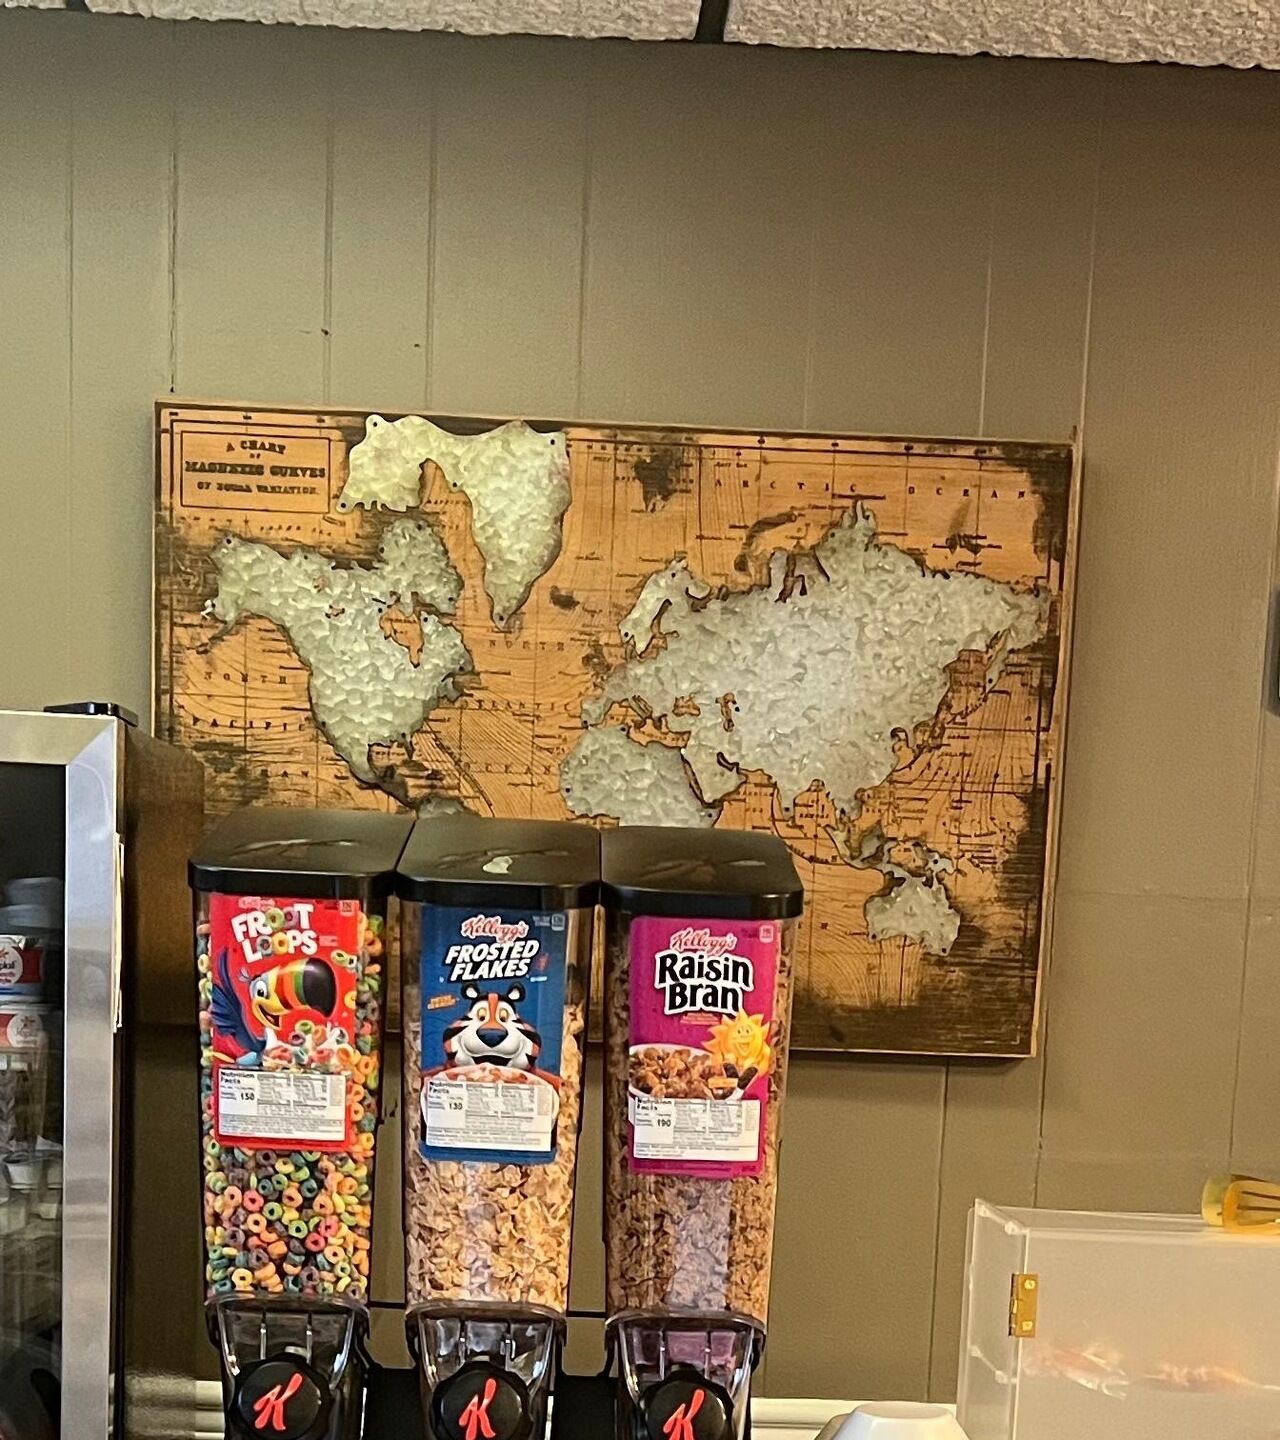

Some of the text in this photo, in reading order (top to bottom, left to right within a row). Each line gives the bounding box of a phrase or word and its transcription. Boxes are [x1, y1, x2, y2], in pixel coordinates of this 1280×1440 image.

[240, 440, 286, 454] CHART
[231, 903, 314, 942] FROOT
[462, 915, 529, 942] Kellogg's
[242, 929, 318, 963] LOOPS
[445, 940, 540, 964] FROSTED
[670, 927, 737, 955] Kellogg's
[450, 958, 531, 981] FLAKES
[658, 952, 751, 988] Raisin
[668, 982, 739, 1012] Bran
